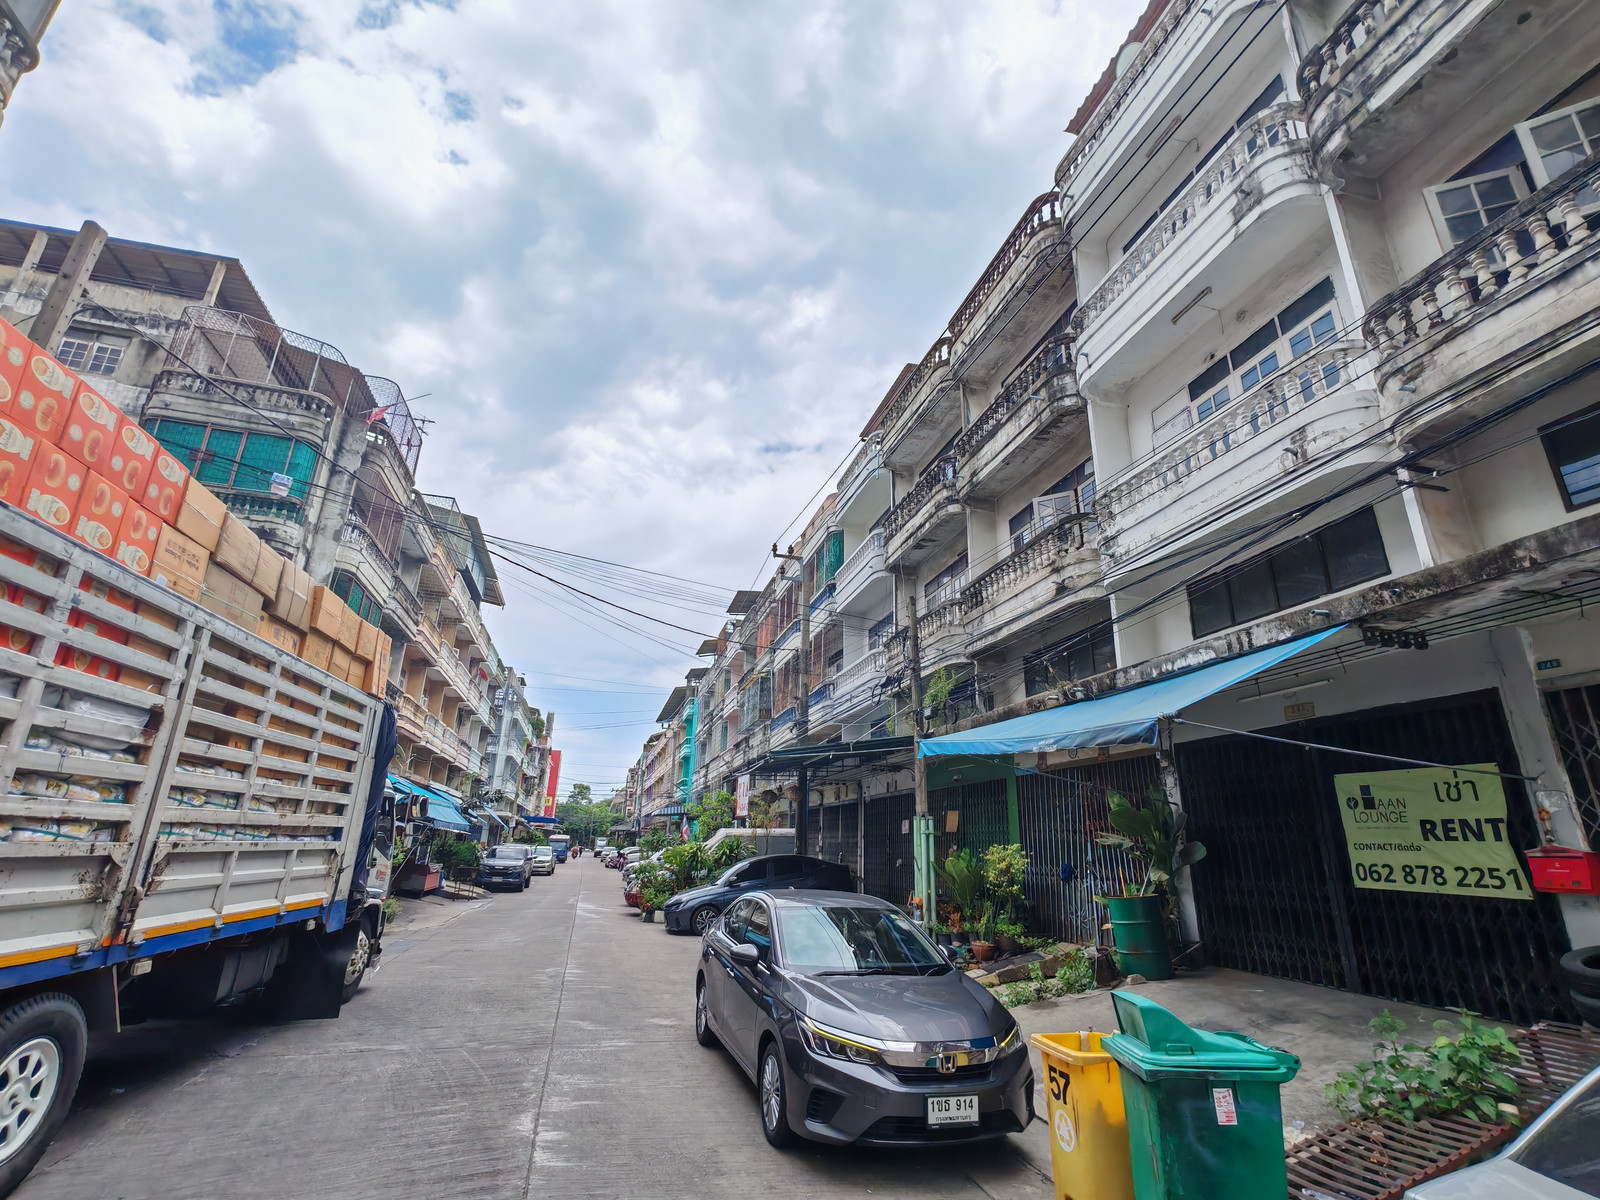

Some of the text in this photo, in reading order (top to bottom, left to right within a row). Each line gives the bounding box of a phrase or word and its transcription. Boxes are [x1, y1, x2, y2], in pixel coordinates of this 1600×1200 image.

[1433, 770, 1480, 803] เช่า
[1353, 810, 1409, 824] LOUNGE
[1419, 818, 1505, 842] RENT
[1355, 863, 1523, 890] 062 878 2251
[1048, 1063, 1071, 1106] 57
[955, 1098, 974, 1111] 914
